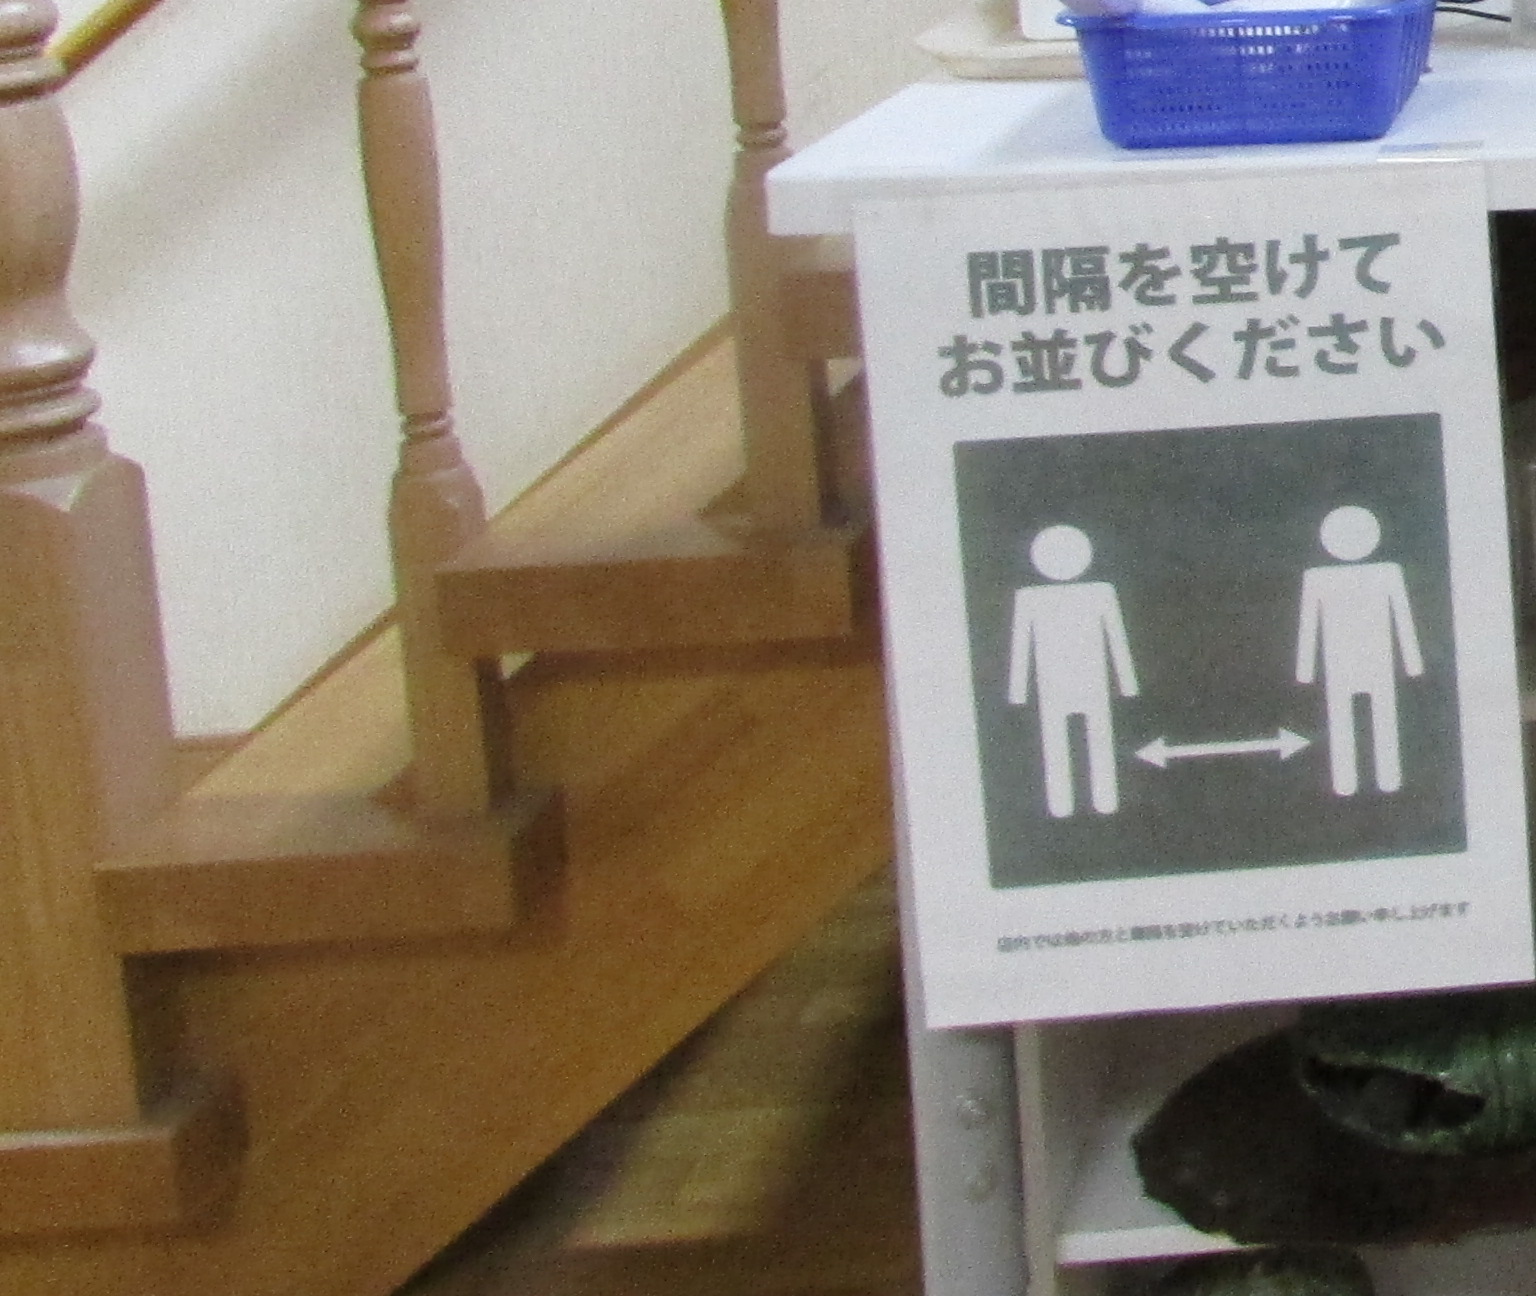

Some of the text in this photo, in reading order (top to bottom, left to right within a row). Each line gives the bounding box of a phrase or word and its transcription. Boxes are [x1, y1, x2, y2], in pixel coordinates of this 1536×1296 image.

[966, 232, 1402, 319] 間隔を空けて
[938, 313, 1445, 398] お並びください
